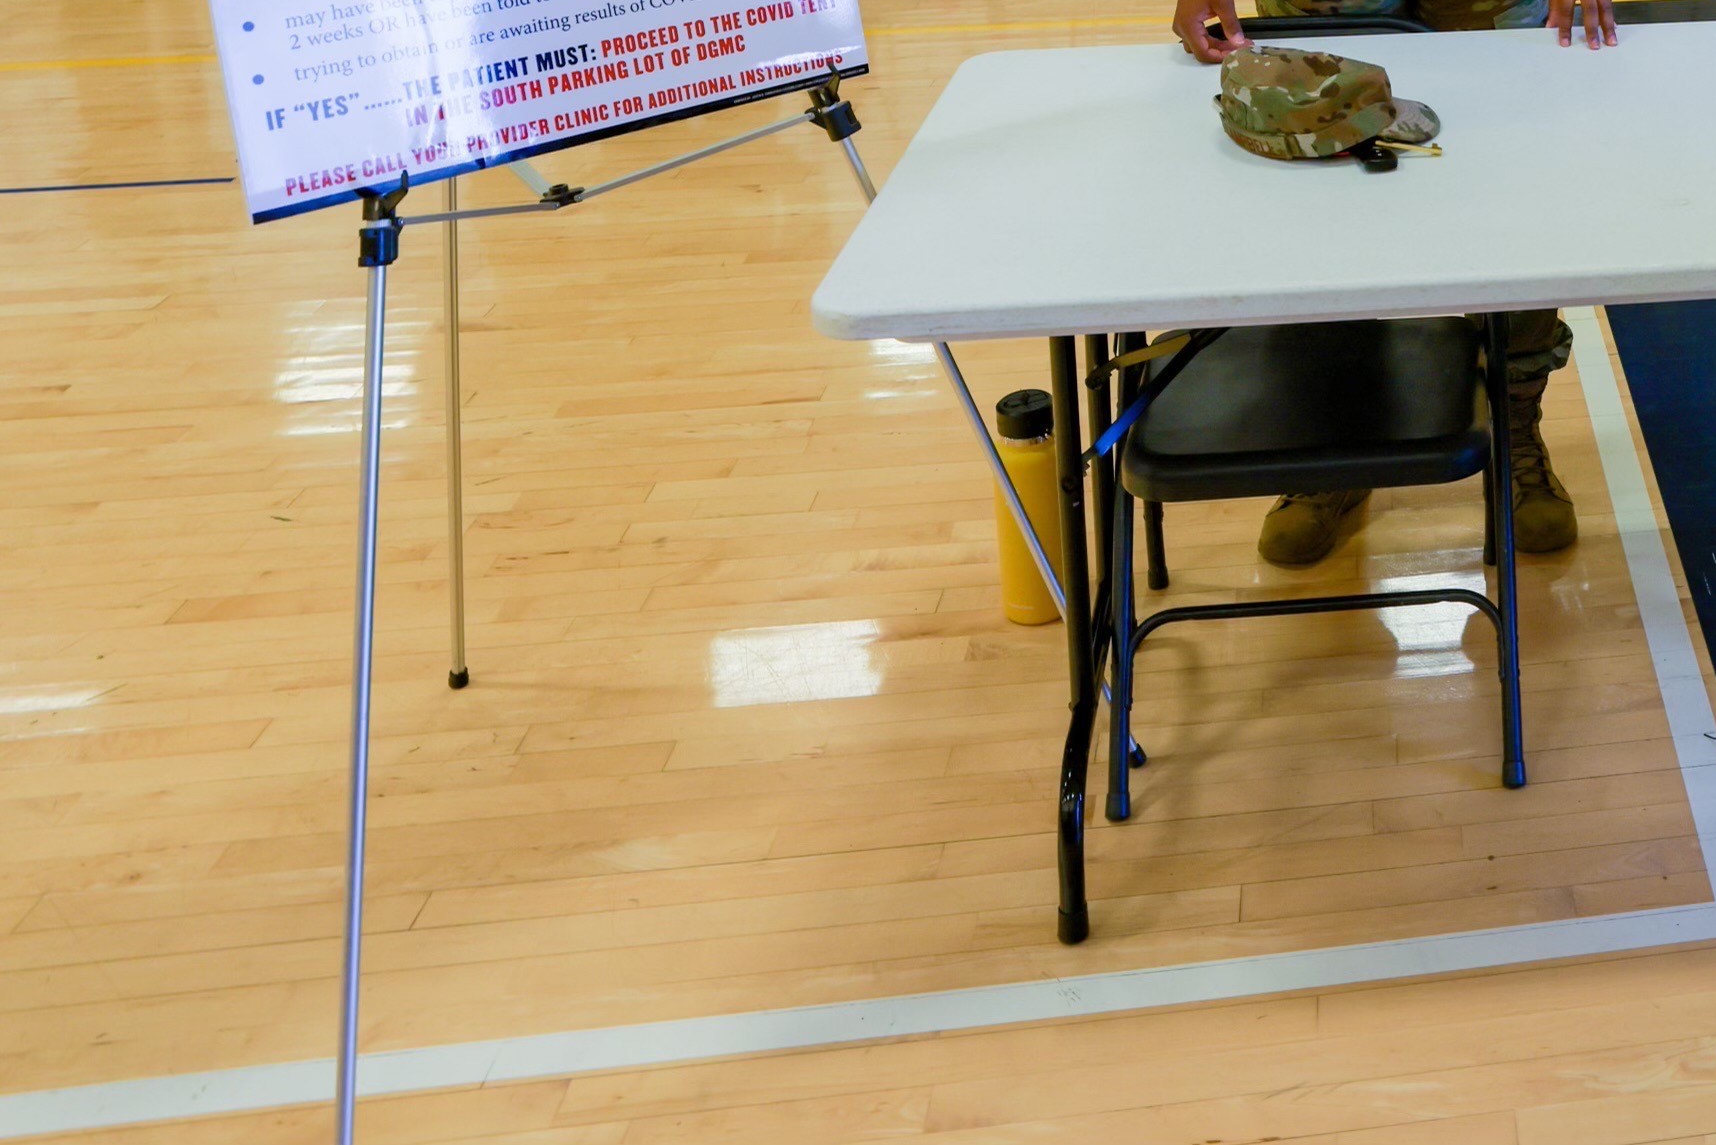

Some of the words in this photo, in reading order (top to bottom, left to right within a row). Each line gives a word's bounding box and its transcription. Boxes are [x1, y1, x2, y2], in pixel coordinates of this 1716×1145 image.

[285, 11, 325, 31] may
[330, 2, 374, 20] have
[289, 33, 301, 50] 2
[306, 20, 364, 44] weeks
[368, 16, 400, 35] OR
[451, 1, 492, 18] been
[294, 59, 353, 83] trying
[357, 52, 377, 68] to
[382, 42, 438, 63] obtain
[469, 30, 495, 46] are
[500, 15, 571, 41] awaiting
[574, 0, 626, 25] results
[265, 108, 286, 132] IF
[448, 57, 530, 92] PATIENT
[535, 43, 597, 73] MUST:
[600, 25, 679, 58] PROCEED
[683, 19, 706, 40] TO
[709, 11, 743, 34] THE
[746, 0, 793, 27] COVID
[405, 104, 429, 128] IN
[479, 79, 543, 111] SOUTH
[547, 54, 629, 96] PARKING
[633, 52, 665, 75] LOT
[671, 45, 690, 67] OF
[695, 36, 746, 61] DGMC
[285, 164, 357, 197] PLEASE
[361, 152, 408, 178] CALL
[554, 104, 609, 133] CLINIC
[613, 96, 644, 118] FOR
[648, 74, 736, 111] ADDITIONAL
